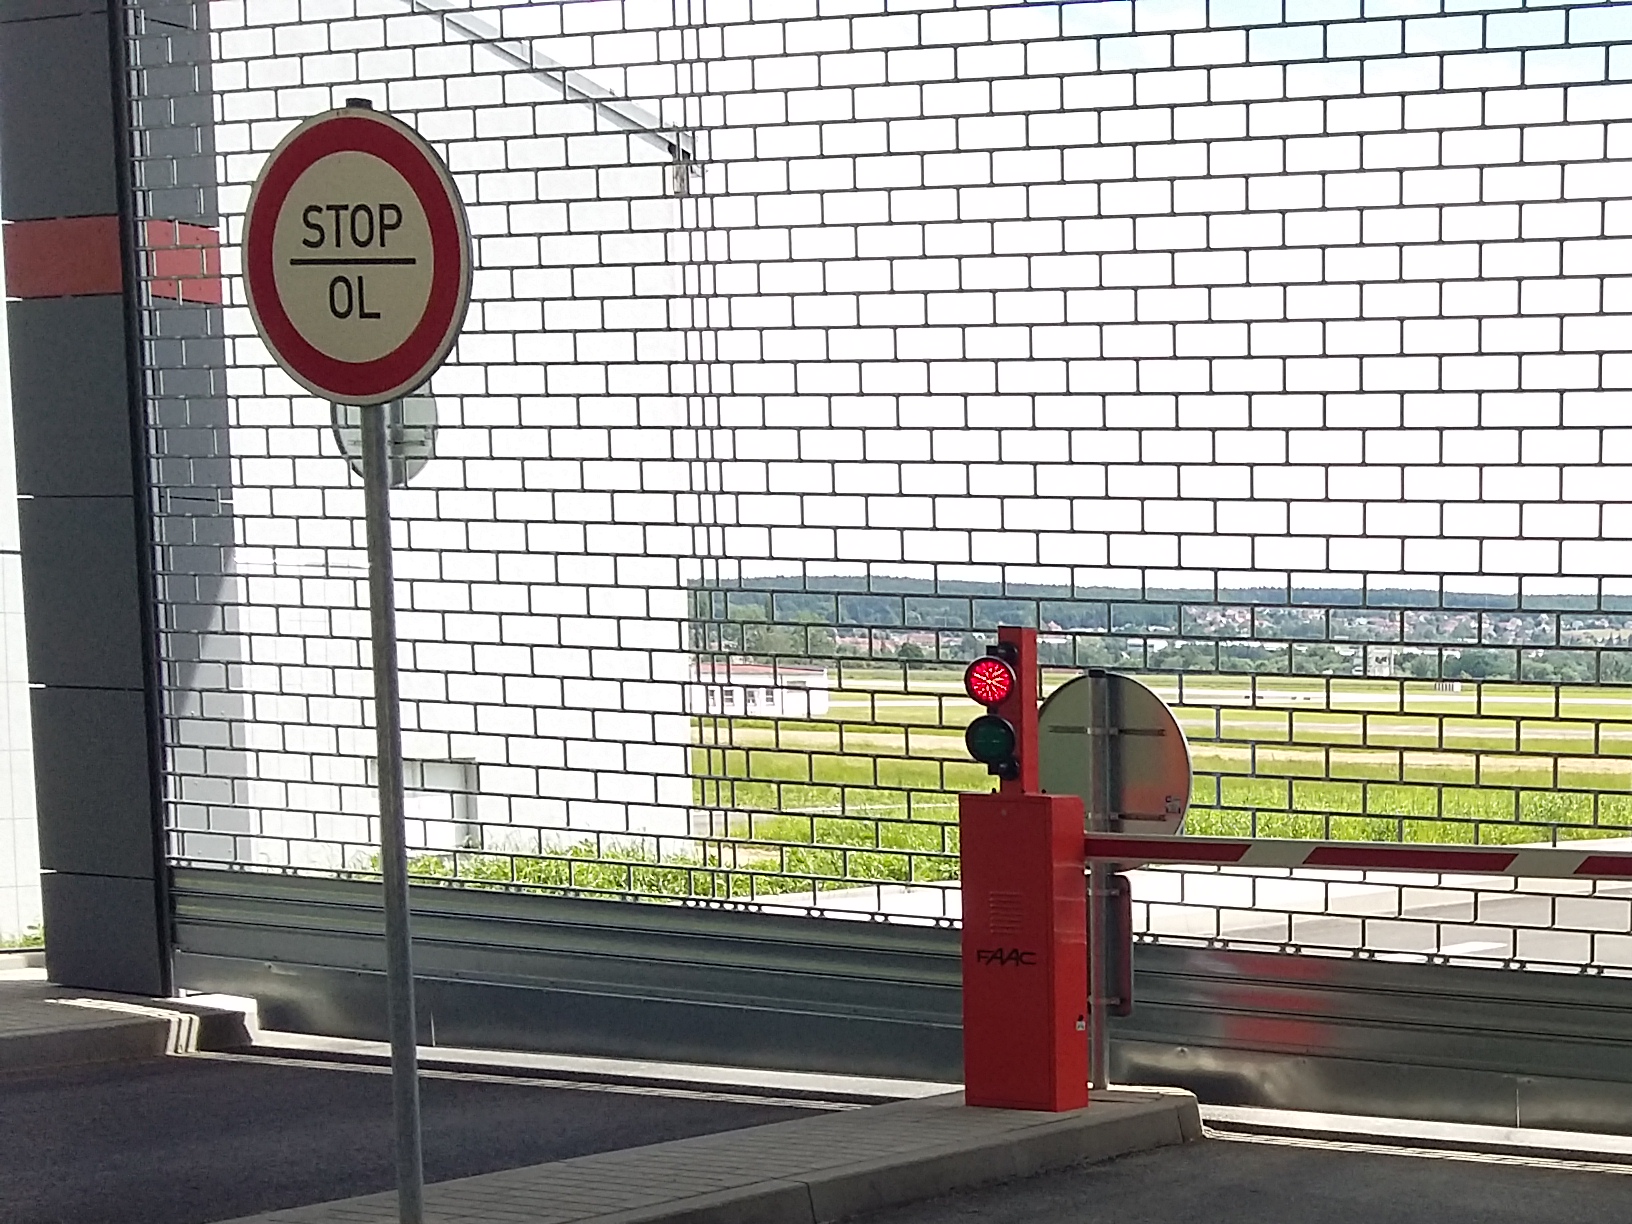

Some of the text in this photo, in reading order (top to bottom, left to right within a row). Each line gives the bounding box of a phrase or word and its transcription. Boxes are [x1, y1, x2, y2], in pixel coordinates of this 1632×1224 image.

[302, 204, 402, 248] STOP
[329, 275, 381, 319] OL
[976, 947, 1037, 967] FAAC
